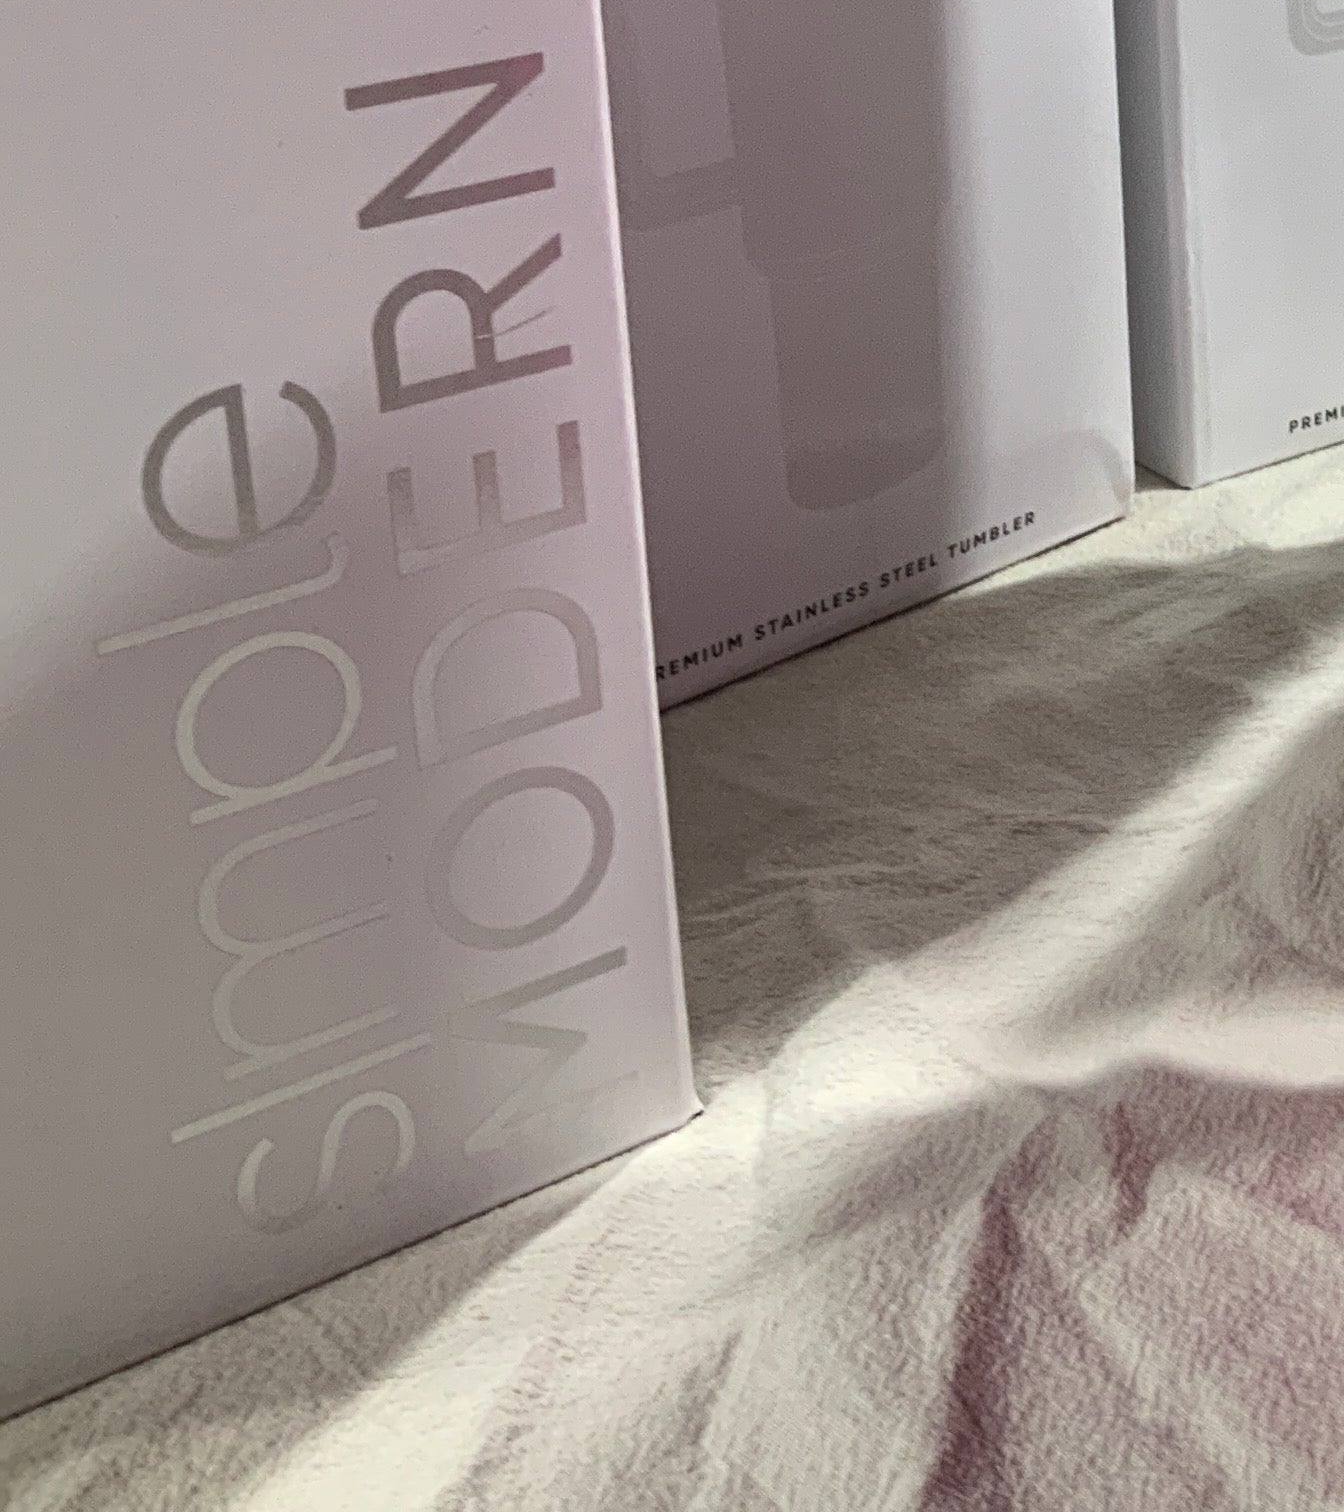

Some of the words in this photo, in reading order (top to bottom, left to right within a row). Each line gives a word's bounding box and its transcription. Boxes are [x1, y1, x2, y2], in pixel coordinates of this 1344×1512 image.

[343, 51, 640, 1157] MODERN
[754, 581, 871, 641] STAINLESS
[878, 552, 938, 589] STEEL
[946, 511, 1036, 559] TUMBLER
